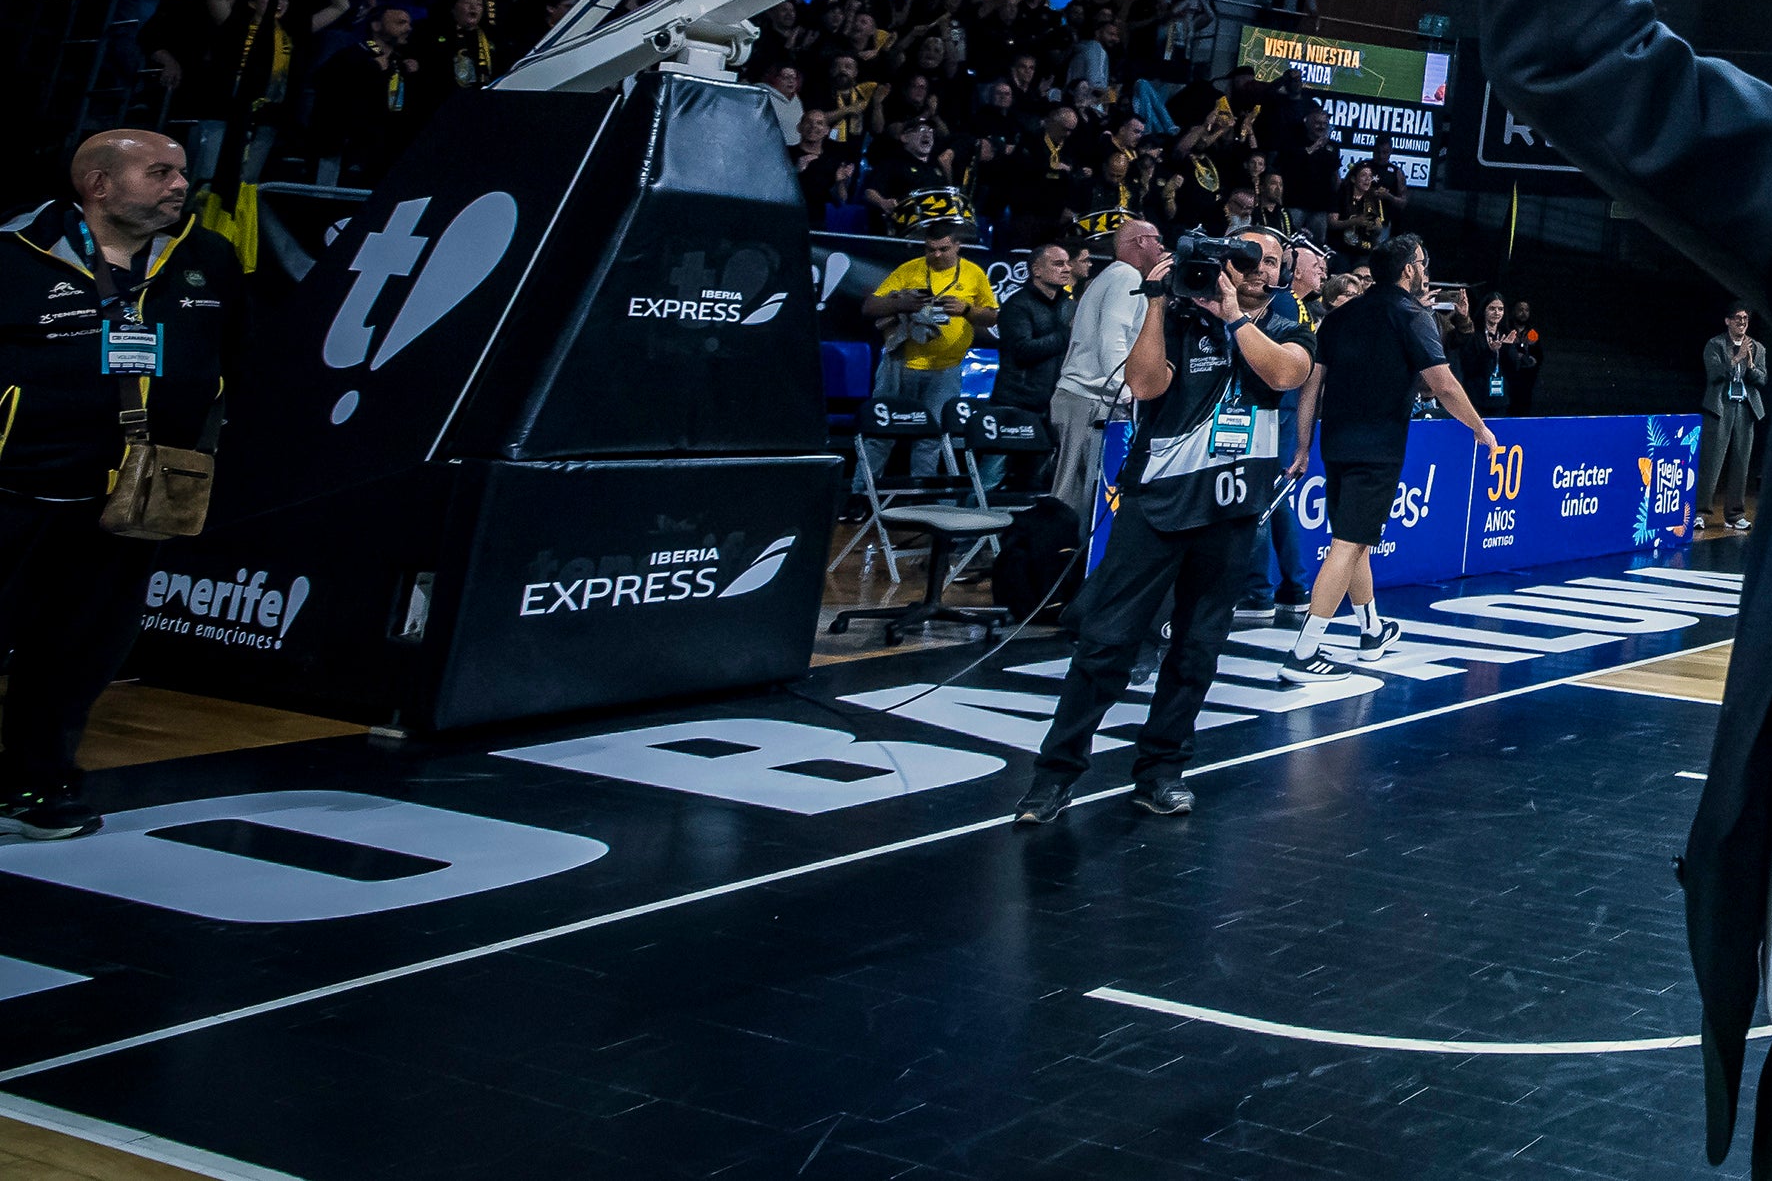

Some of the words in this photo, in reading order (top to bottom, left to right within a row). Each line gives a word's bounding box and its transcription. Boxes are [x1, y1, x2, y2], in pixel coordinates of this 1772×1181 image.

[1264, 36, 1302, 60] VISITA
[1306, 44, 1360, 68] NUESTRA
[1312, 97, 1433, 136] ARPINTERIA
[1352, 132, 1378, 146] META
[701, 289, 743, 300] IBERIA
[628, 298, 742, 323] EXPRESS
[1487, 444, 1524, 502] 50
[1552, 462, 1613, 489] Carácter
[1215, 466, 1248, 507] 05
[1561, 492, 1599, 518] único
[1484, 506, 1516, 533] AÑOS
[1482, 534, 1514, 549] CONTIGO
[650, 547, 719, 565] IBERIA
[520, 568, 718, 616] EXPRESS
[140, 612, 191, 635] pierta
